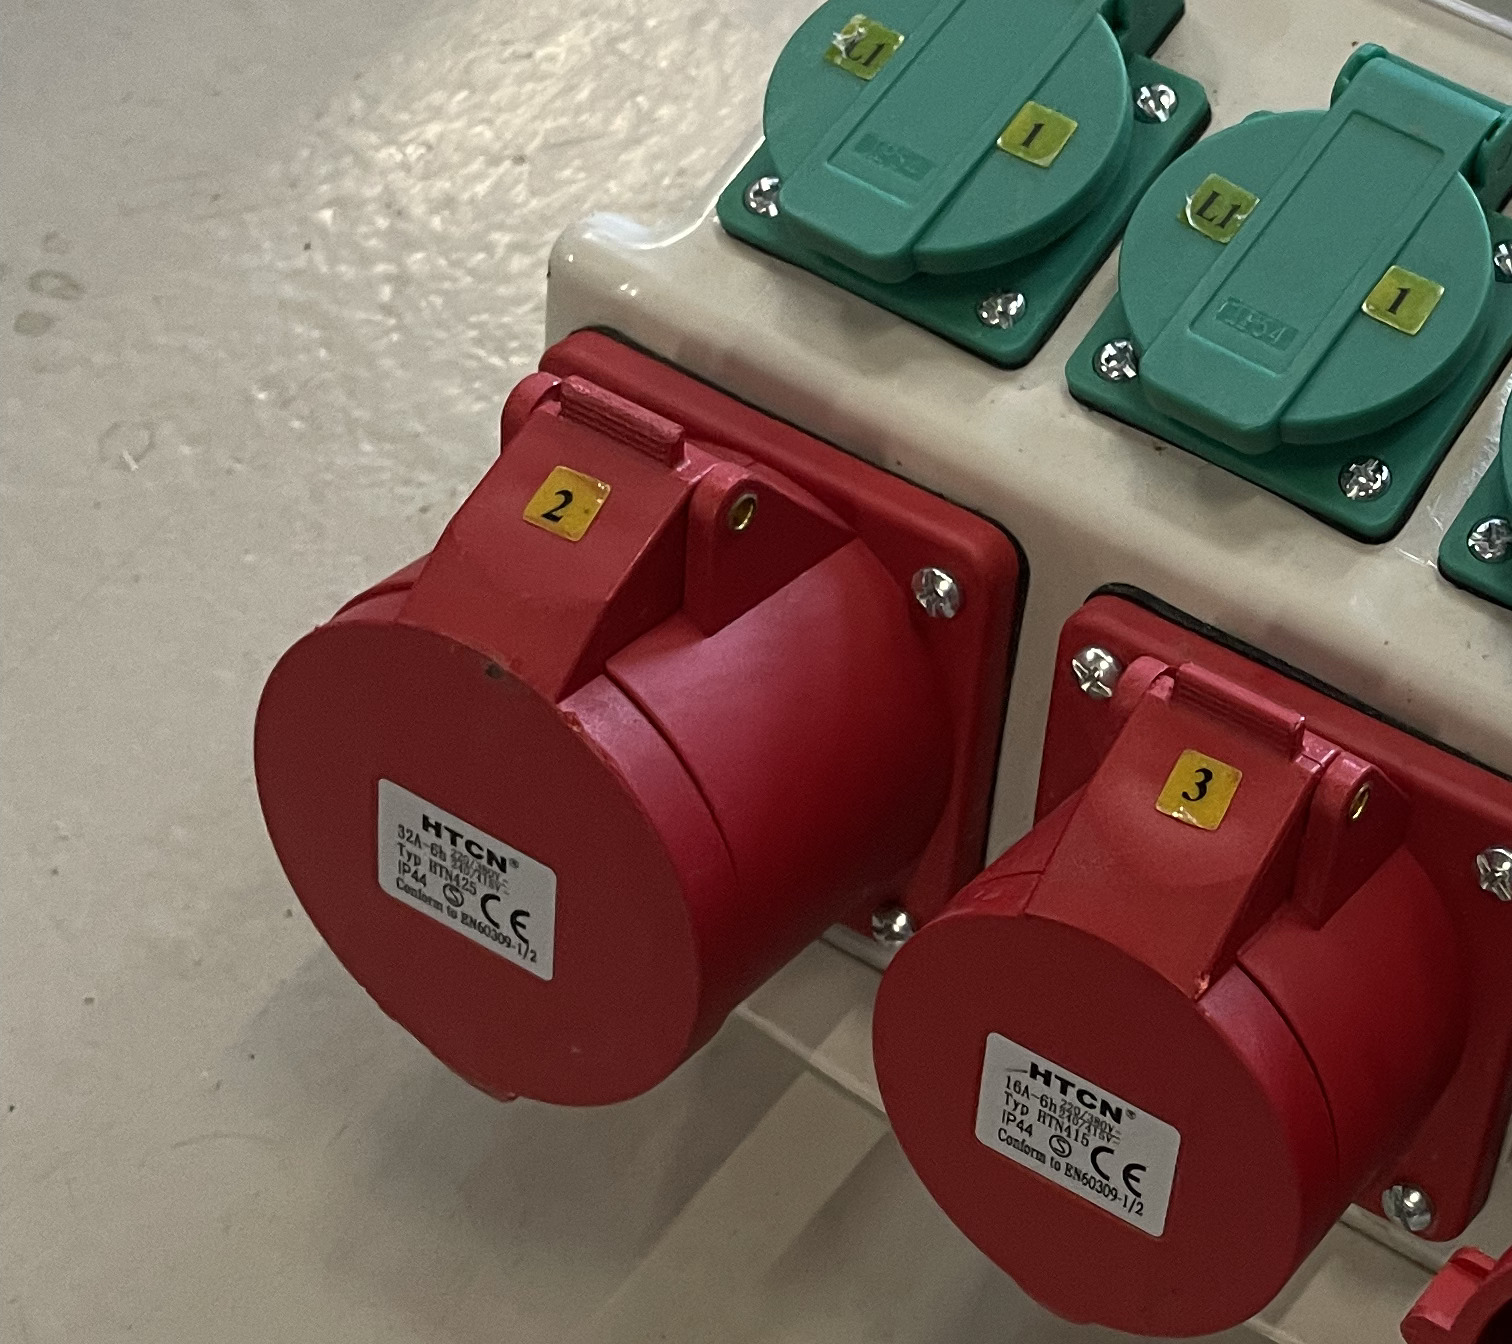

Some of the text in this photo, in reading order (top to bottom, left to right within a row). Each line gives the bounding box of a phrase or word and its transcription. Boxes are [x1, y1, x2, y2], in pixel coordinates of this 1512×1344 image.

[1020, 122, 1046, 148] 1
[1196, 190, 1242, 229] L1
[1387, 286, 1411, 315] 1
[541, 489, 573, 523] 2
[1181, 767, 1213, 802] 3
[396, 877, 443, 914] Conform
[461, 912, 538, 964] EN60309-1/2
[399, 859, 428, 888] IP44
[480, 893, 531, 945] CE
[998, 1128, 1144, 1217] Conform to EN60309-1/2
[1001, 1109, 1034, 1138] IP44
[1090, 1146, 1147, 1199] CE
